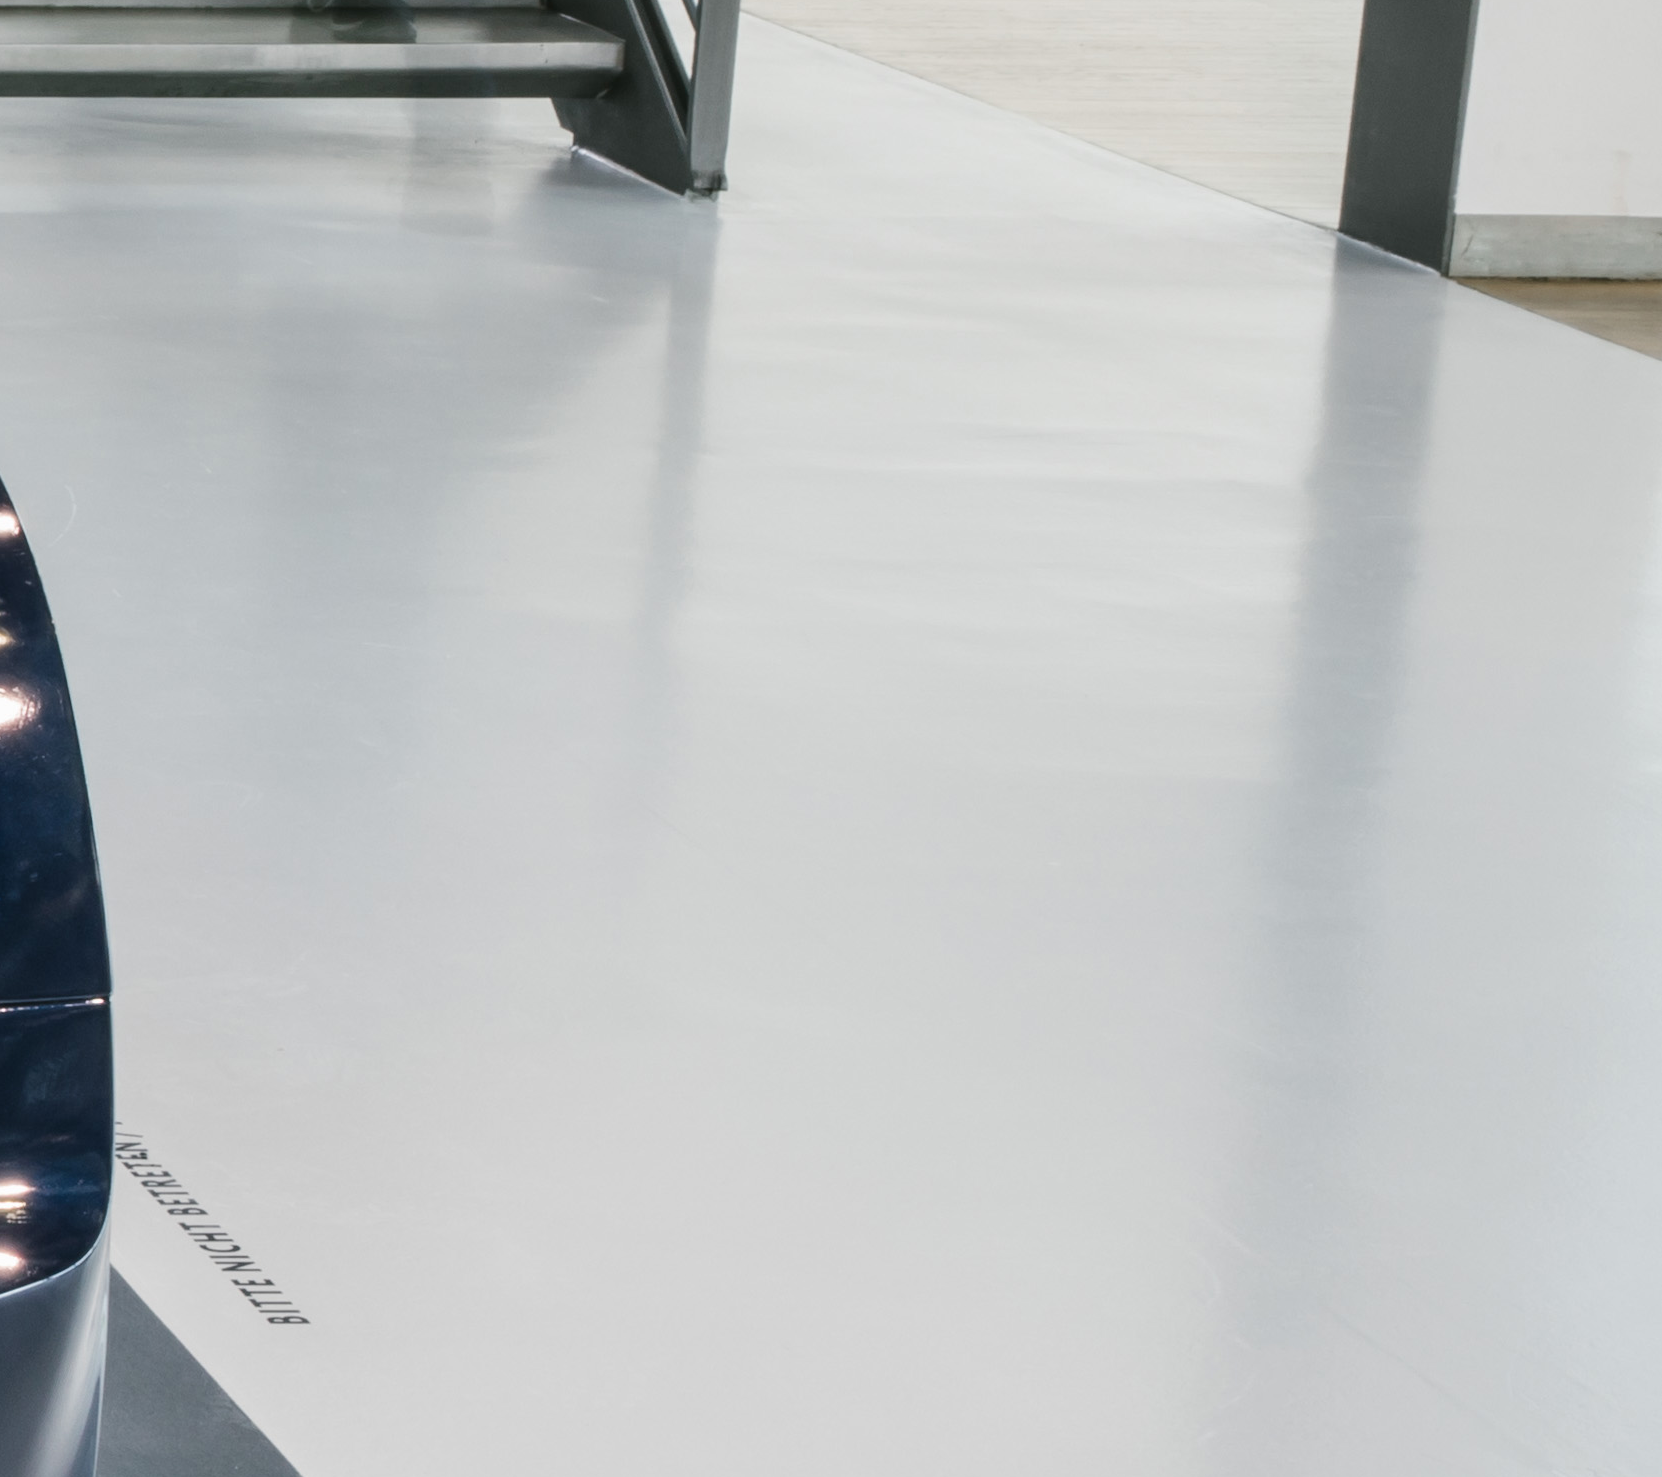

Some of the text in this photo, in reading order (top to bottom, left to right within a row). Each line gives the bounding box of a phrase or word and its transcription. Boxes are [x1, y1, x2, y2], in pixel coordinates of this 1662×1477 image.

[114, 1141, 209, 1215] BETRETEN
[177, 1222, 263, 1272] NICHT
[230, 1278, 311, 1324] BITTE
